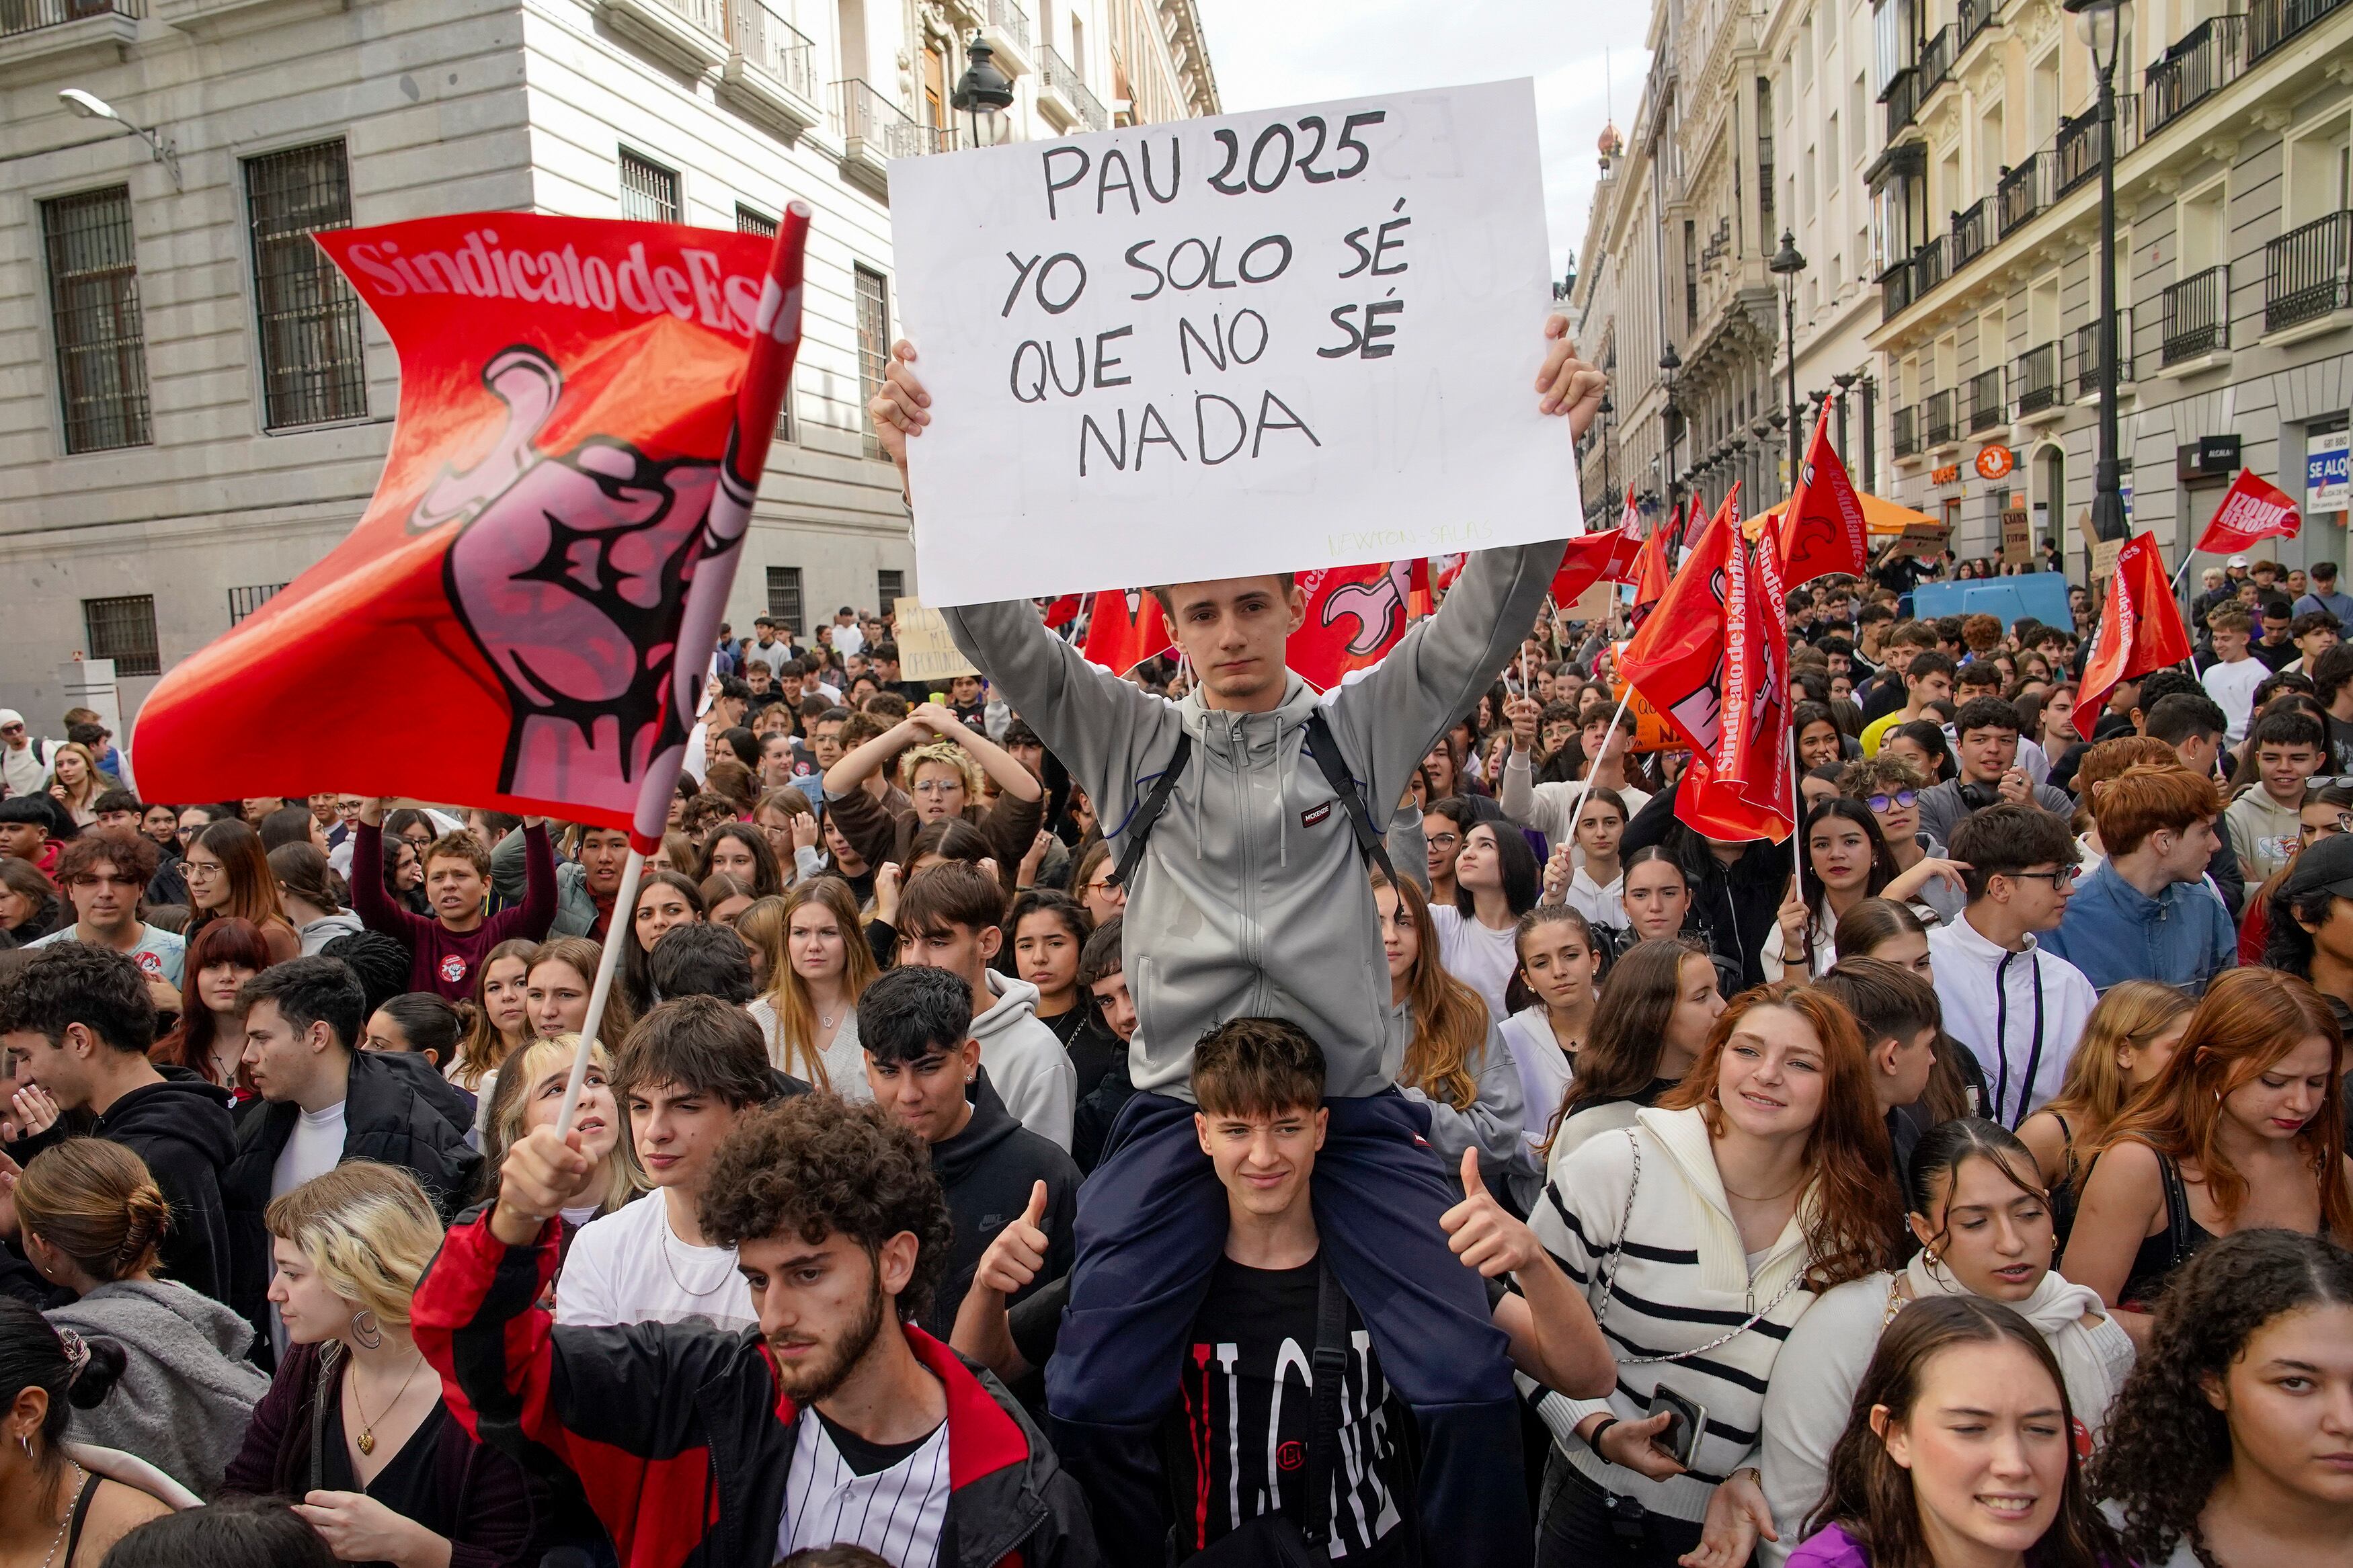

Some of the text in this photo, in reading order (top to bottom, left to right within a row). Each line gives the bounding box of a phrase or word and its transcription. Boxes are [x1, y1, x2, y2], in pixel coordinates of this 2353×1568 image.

[1041, 136, 1181, 220] PAU
[1207, 110, 1387, 196] 2025
[348, 229, 616, 313] Sindicato
[617, 243, 694, 320] de
[1000, 250, 1088, 318] YO
[1124, 234, 1293, 302] SOLO
[1338, 196, 1412, 279] SÉ
[1009, 287, 1404, 403] QUE NO SÉ
[1080, 388, 1322, 477] NADA
[2309, 460, 2323, 479] SE
[1728, 632, 1746, 661] de
[1716, 663, 1744, 772] Sindicato
[1304, 805, 1329, 821] MCKENZIE
